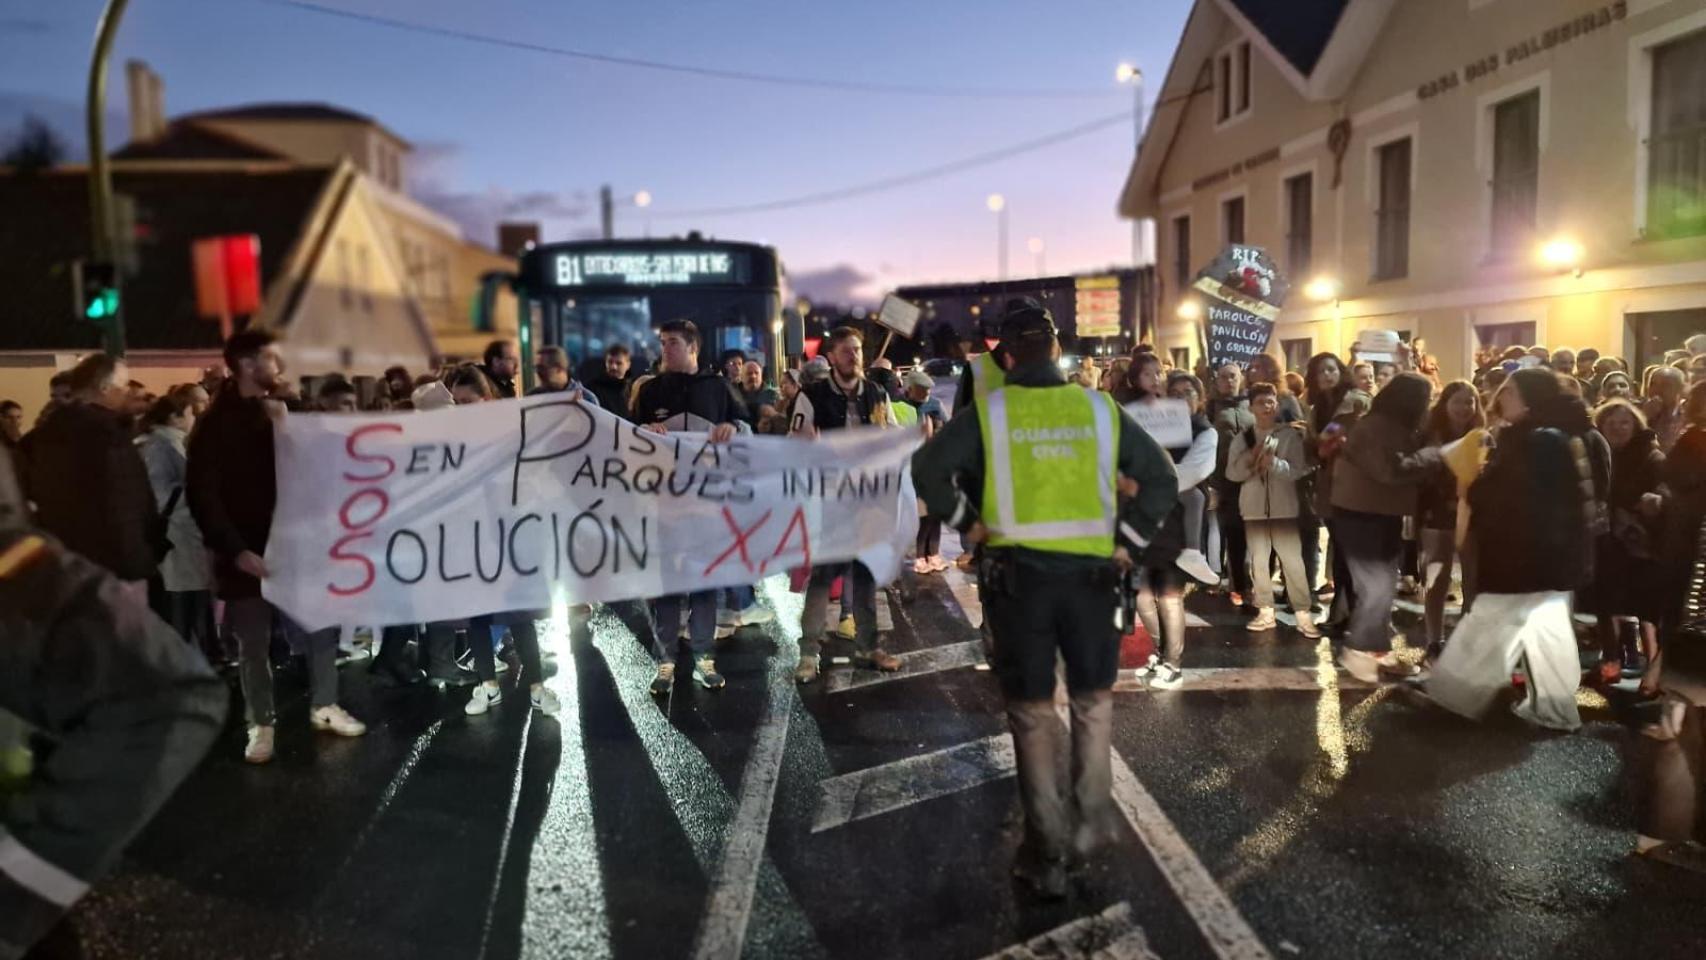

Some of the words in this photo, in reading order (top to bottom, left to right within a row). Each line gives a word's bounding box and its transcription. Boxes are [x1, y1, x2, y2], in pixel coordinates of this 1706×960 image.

[1416, 69, 1459, 100] CASA
[1465, 53, 1499, 82] DAS
[1505, 0, 1628, 65] PALMEIRAS
